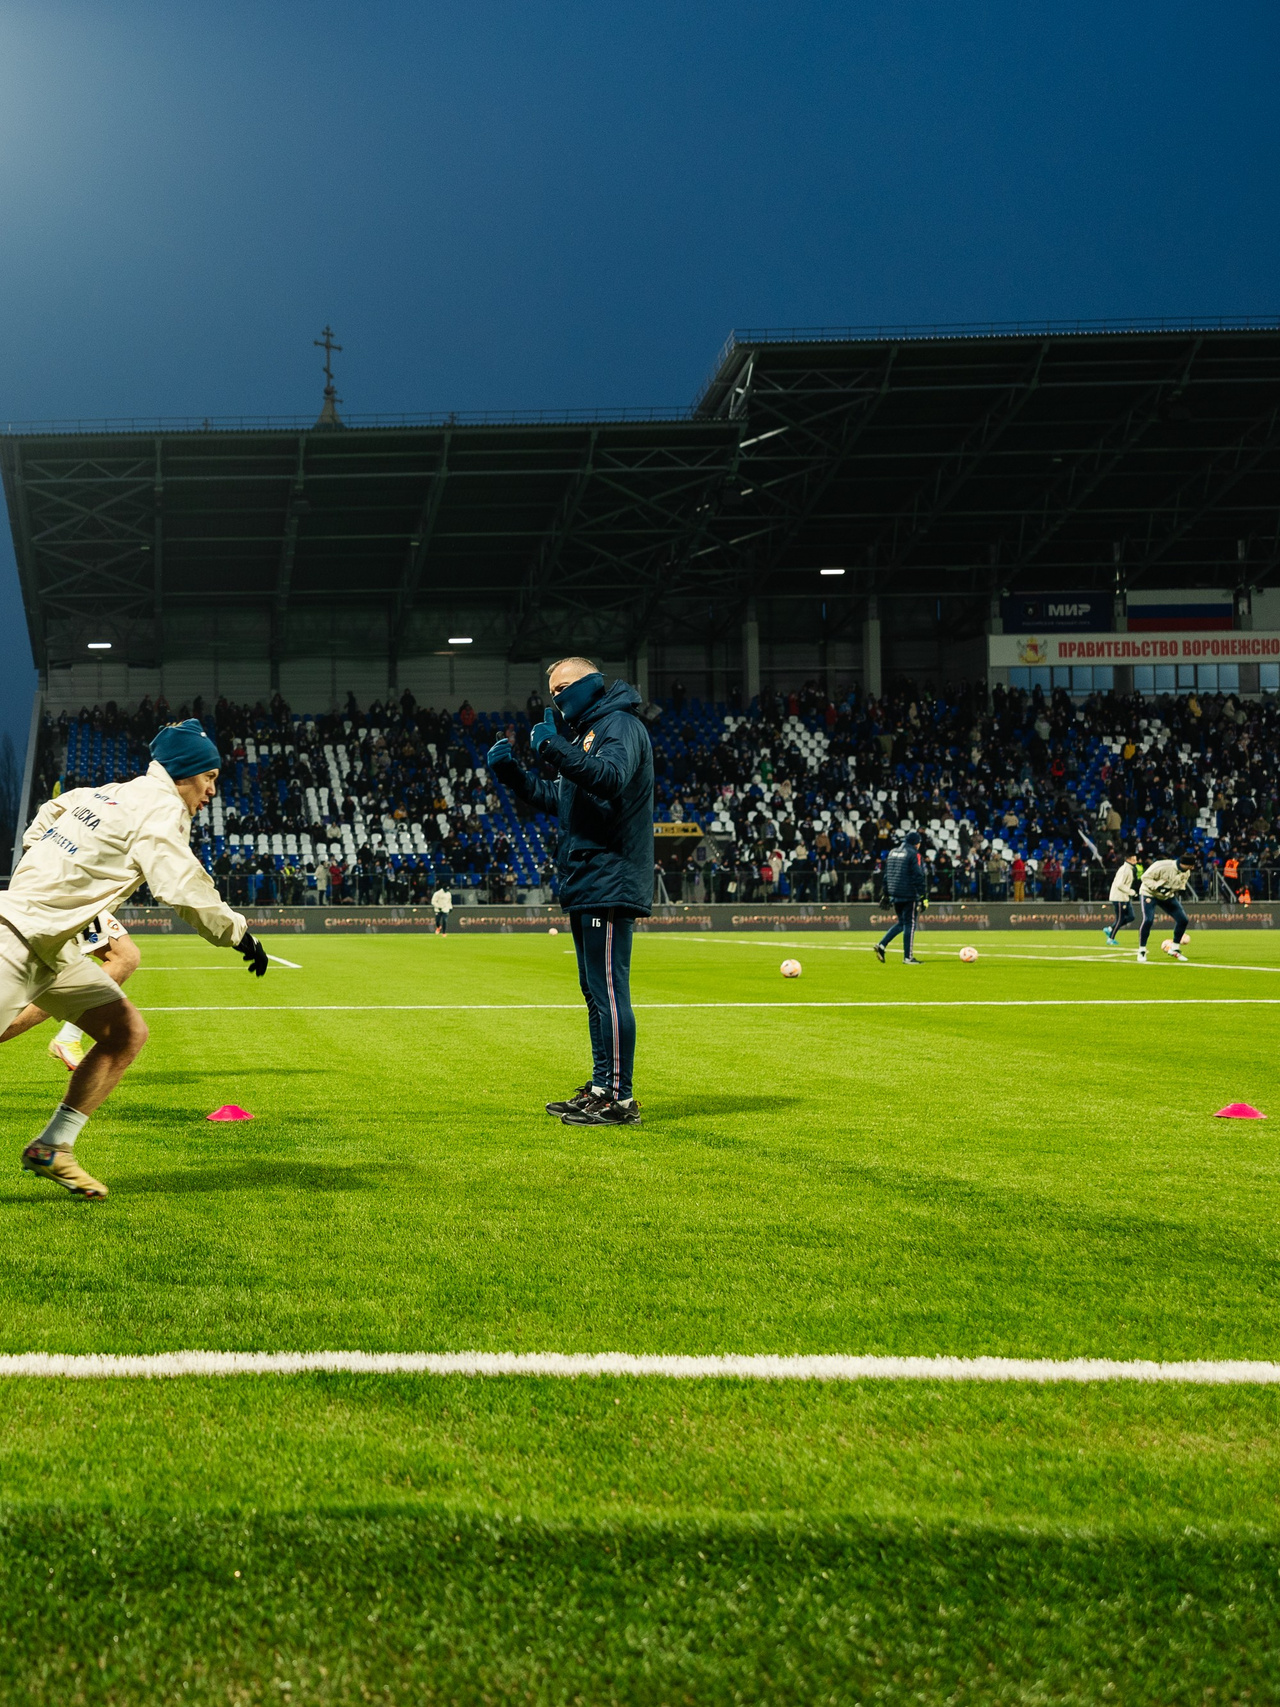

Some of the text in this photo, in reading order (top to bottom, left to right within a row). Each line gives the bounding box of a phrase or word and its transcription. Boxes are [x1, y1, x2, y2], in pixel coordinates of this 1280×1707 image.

[1048, 603, 1091, 617] МИР
[1058, 637, 1280, 659] ПРАВИТЕЛЬСТВО ВОРОНЕЖСКО
[592, 917, 601, 928] ГБ
